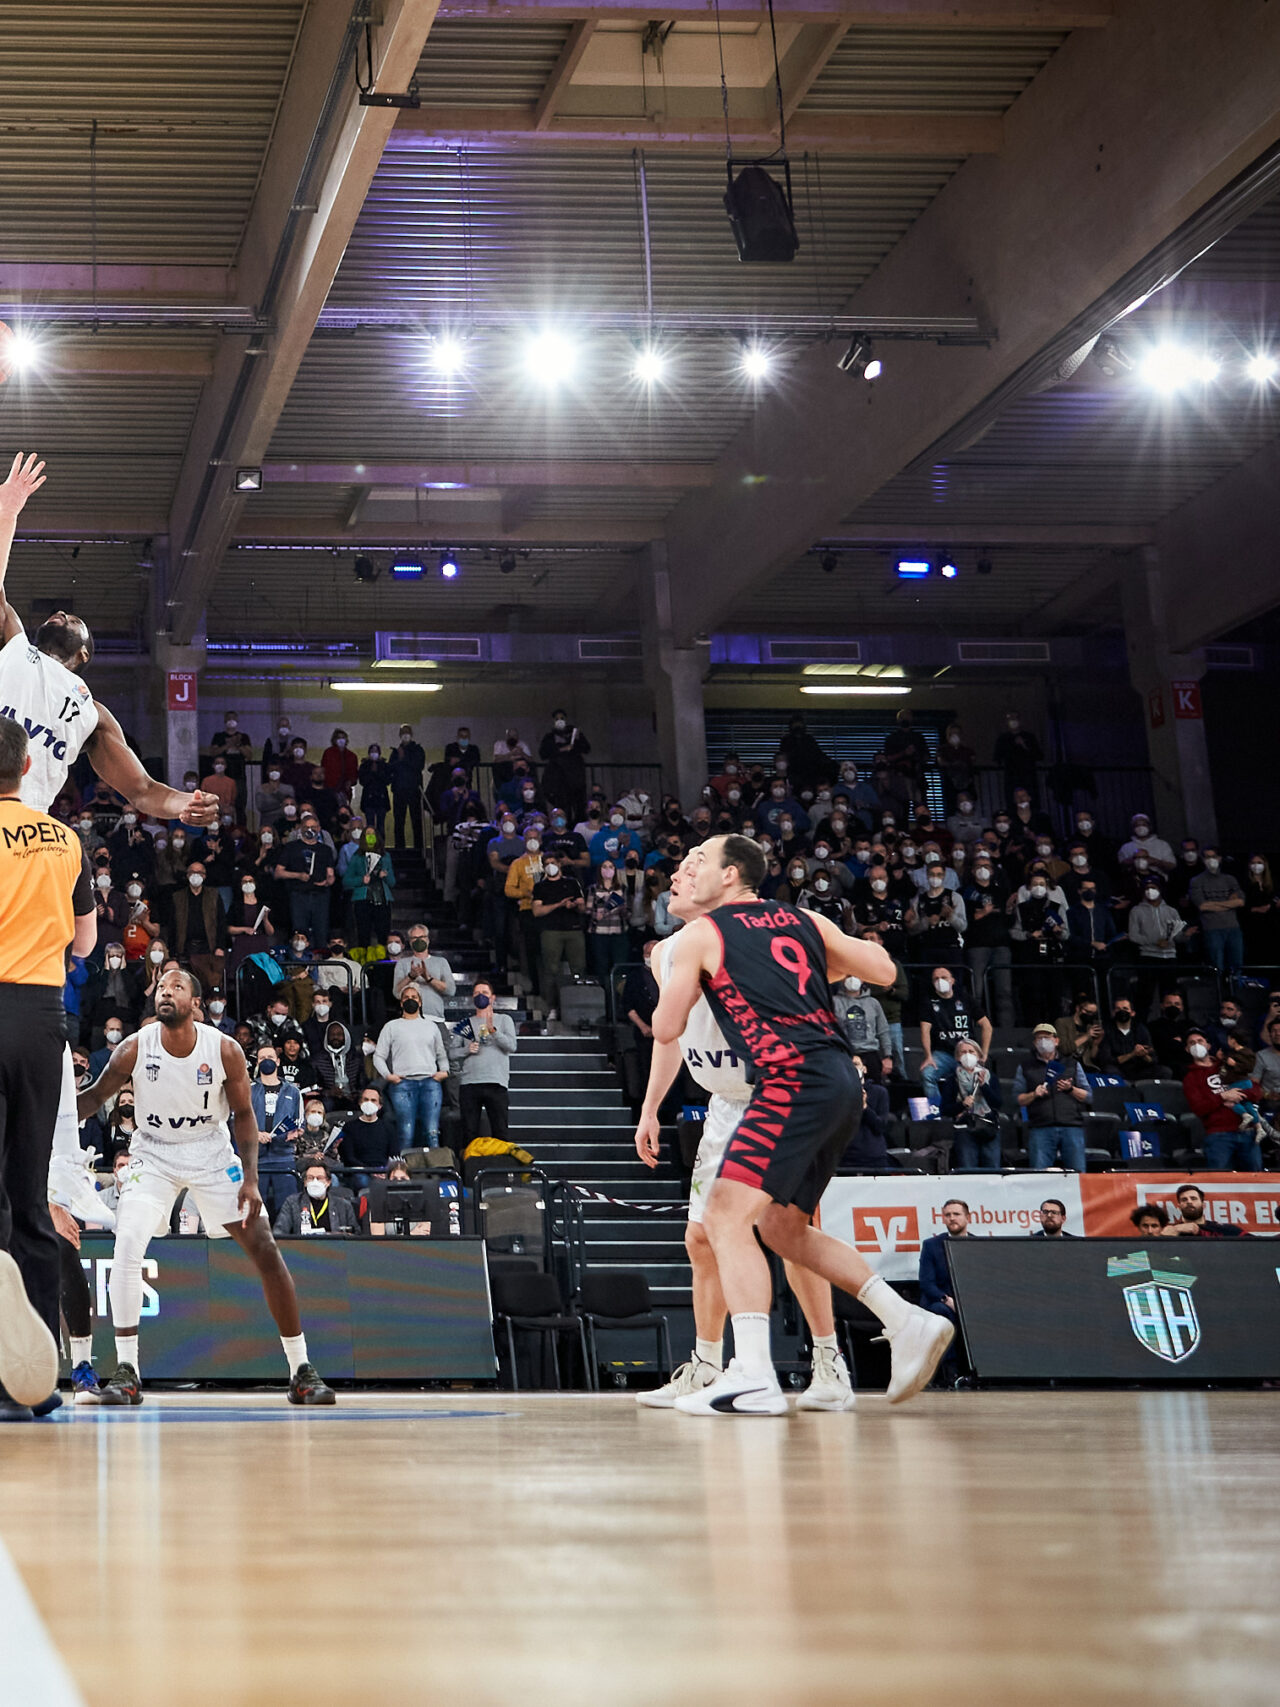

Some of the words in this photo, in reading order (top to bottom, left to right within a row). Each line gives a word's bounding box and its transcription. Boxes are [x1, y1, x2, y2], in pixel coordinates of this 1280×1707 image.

[175, 682, 189, 702] J
[1178, 690, 1195, 710] K
[733, 907, 802, 930] Tadda
[128, 925, 137, 937] 2
[771, 936, 812, 996] 9
[954, 1015, 969, 1029] 82
[705, 1050, 739, 1068] VT
[282, 1065, 300, 1076] NETS
[203, 1090, 209, 1109] 1
[931, 1205, 1041, 1229] Hmburge
[1156, 1200, 1249, 1225] MER
